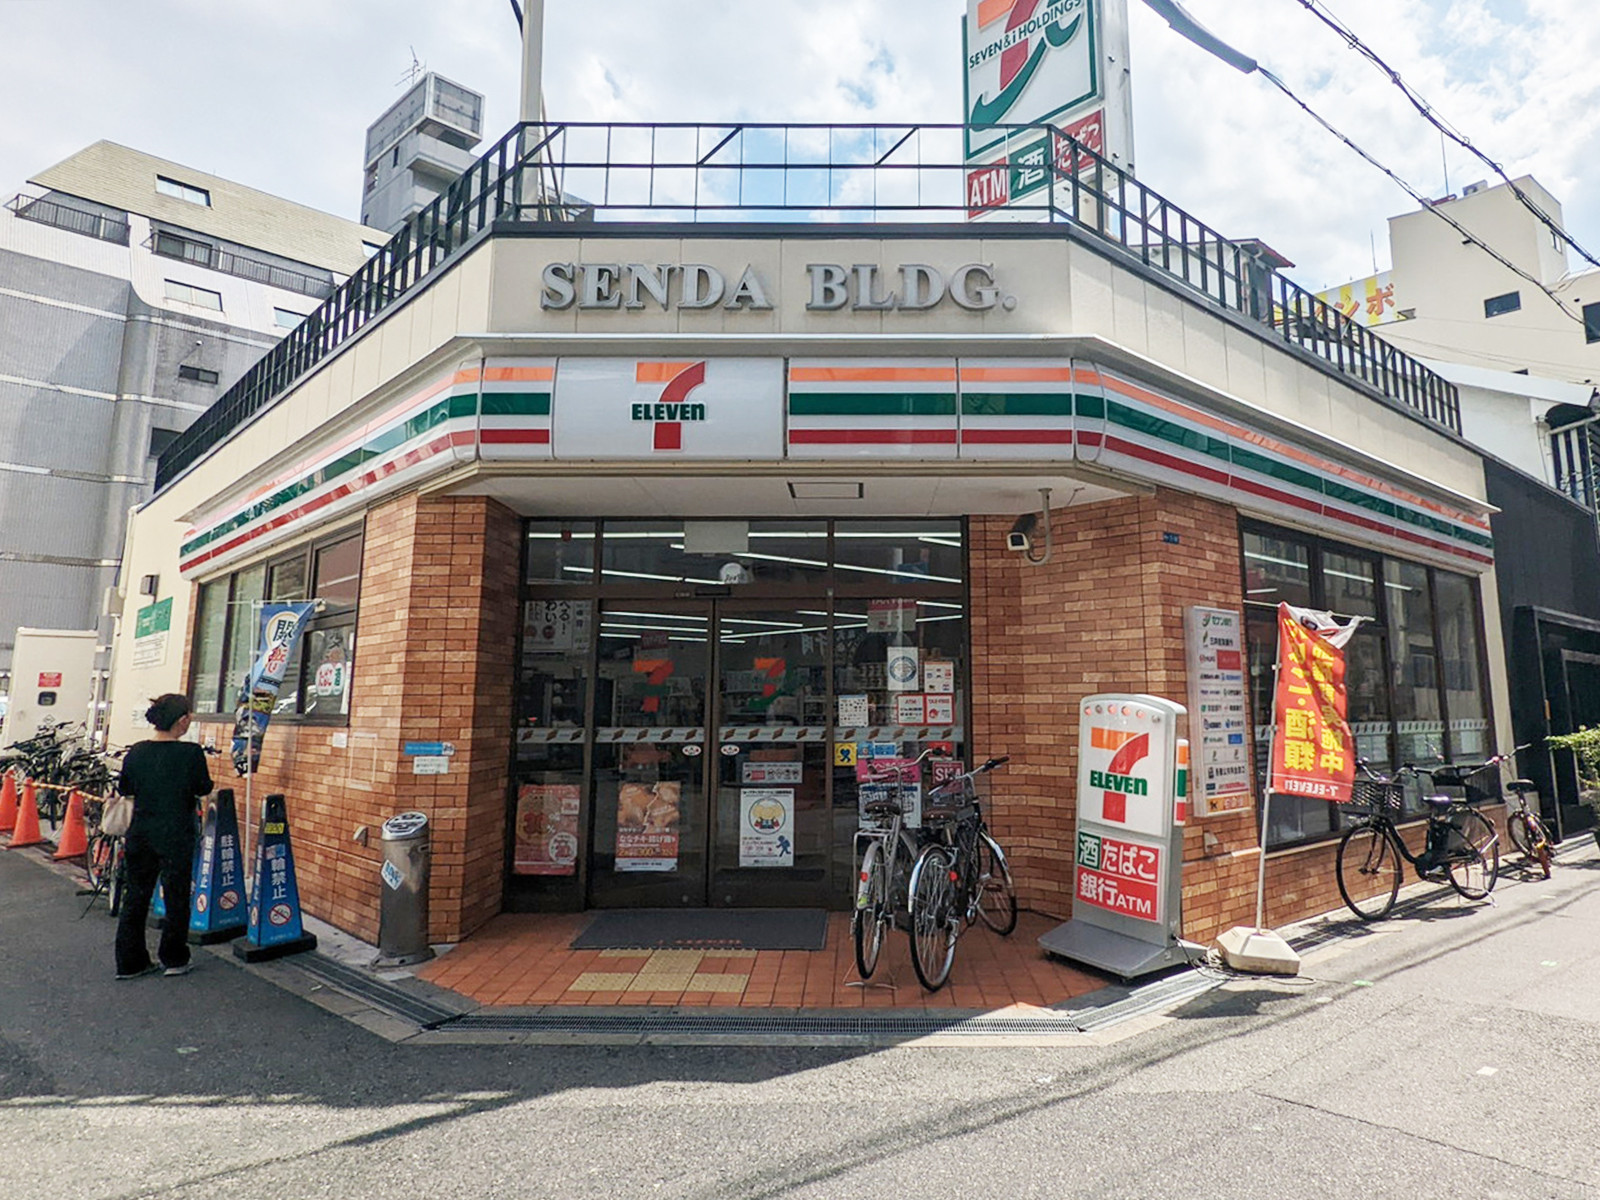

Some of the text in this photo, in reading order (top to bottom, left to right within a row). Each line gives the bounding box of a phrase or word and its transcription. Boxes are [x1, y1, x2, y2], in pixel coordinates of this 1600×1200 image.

[1018, 0, 1082, 40] HOLDINGS
[1018, 147, 1044, 190] 酒
[1056, 124, 1102, 168] たばこ
[970, 170, 1006, 208] ATM
[541, 262, 1017, 311] SENDA BLDG.
[221, 834, 234, 886] 駐輪禁止
[267, 844, 288, 900] 輪禁止
[1079, 834, 1155, 880] 酒 たばこ
